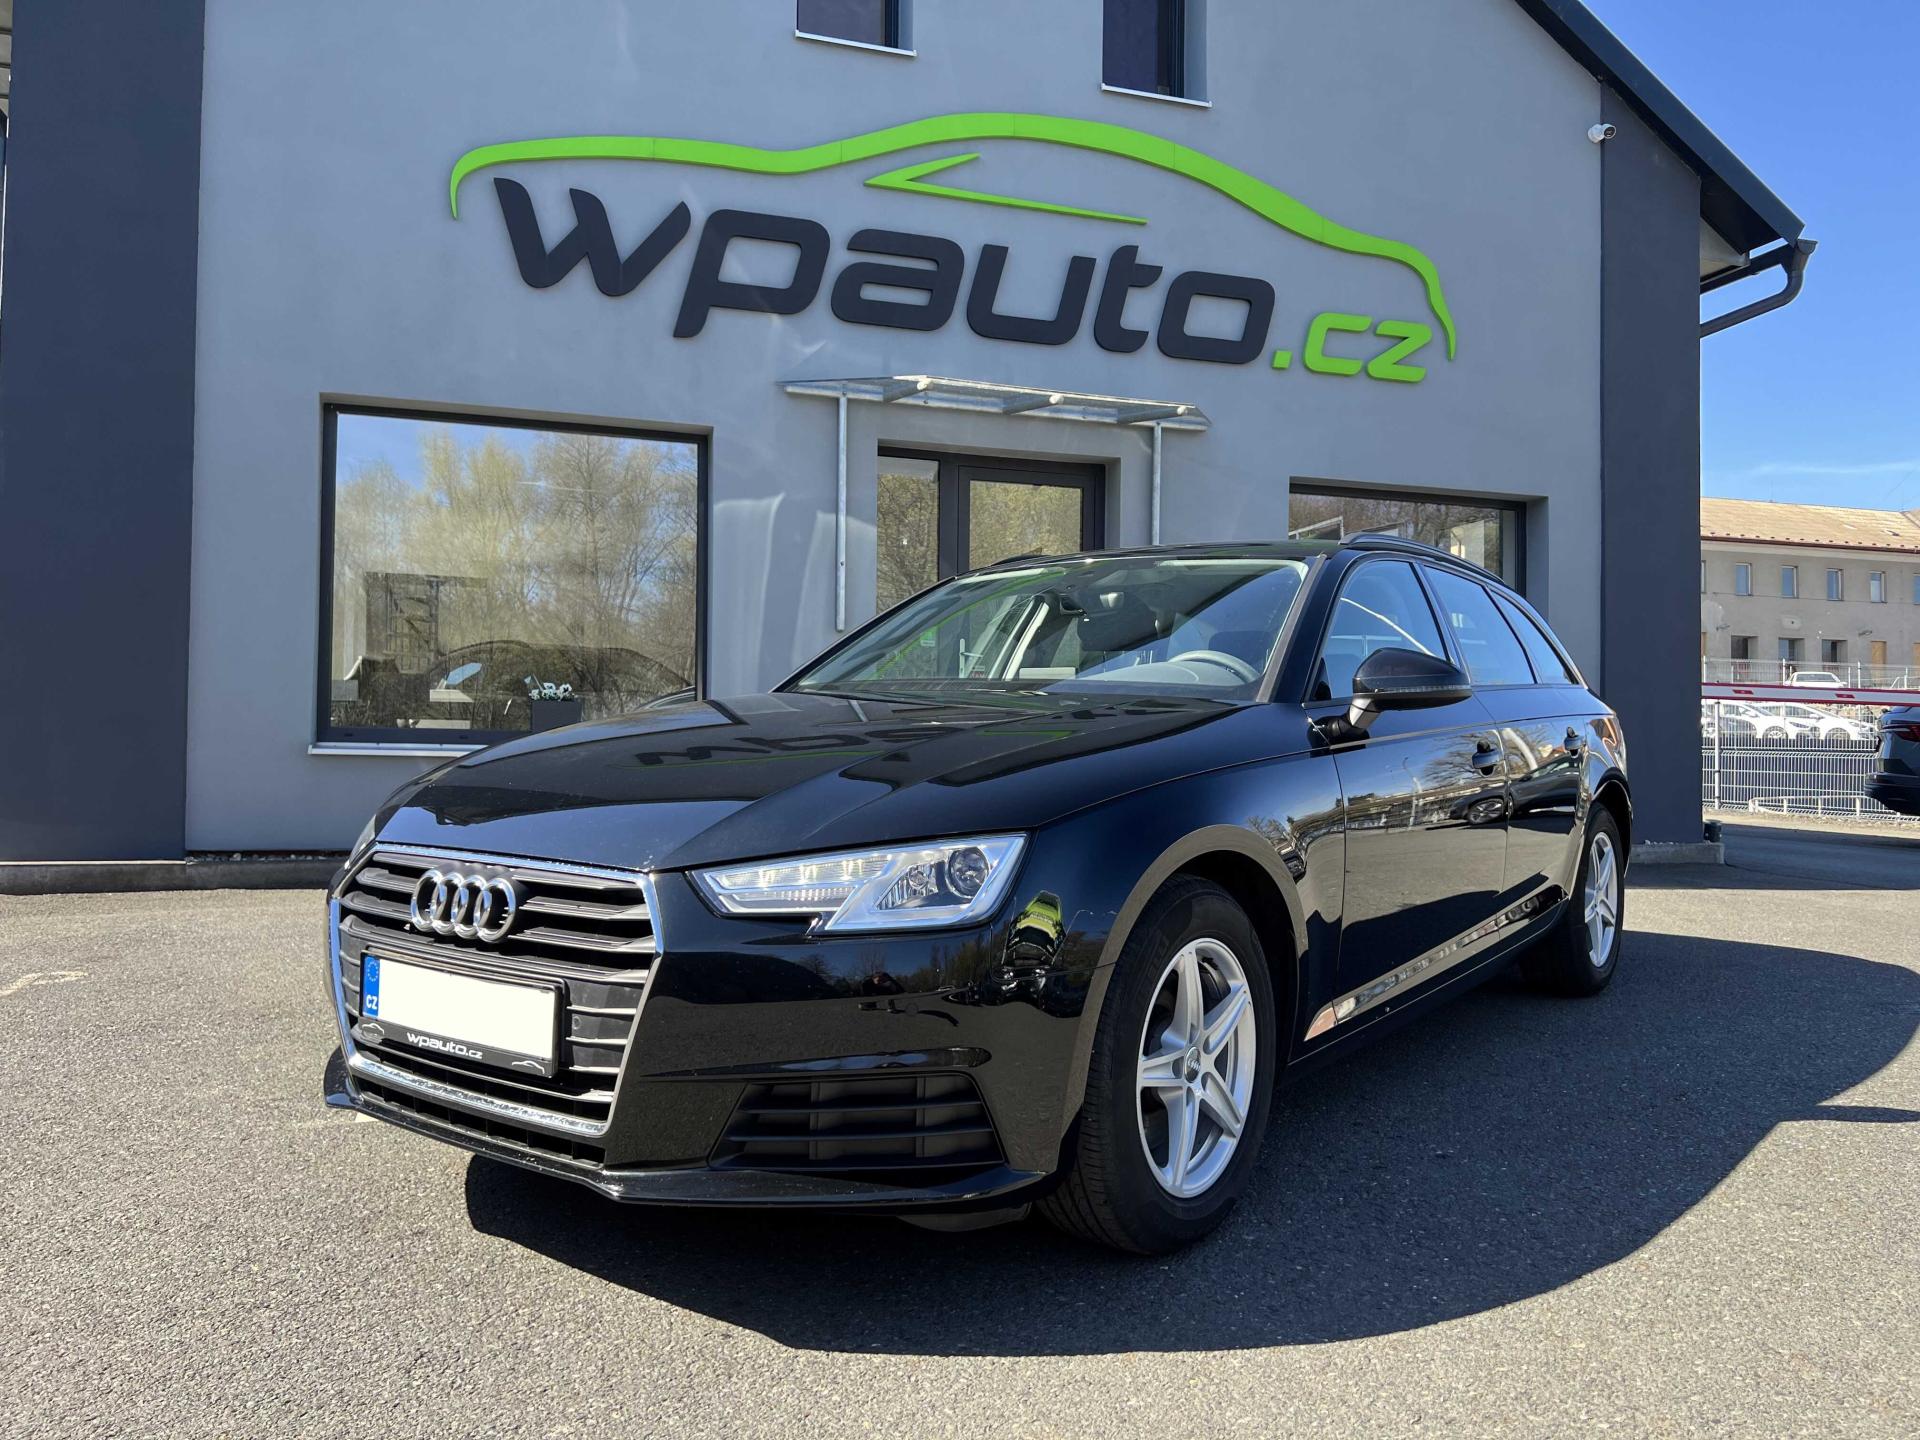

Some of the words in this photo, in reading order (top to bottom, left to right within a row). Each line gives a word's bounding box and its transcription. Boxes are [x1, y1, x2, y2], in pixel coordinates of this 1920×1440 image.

[494, 178, 1431, 383] wpauto.cz
[366, 995, 378, 1010] CZ
[406, 1032, 483, 1059] wpauto.cz
